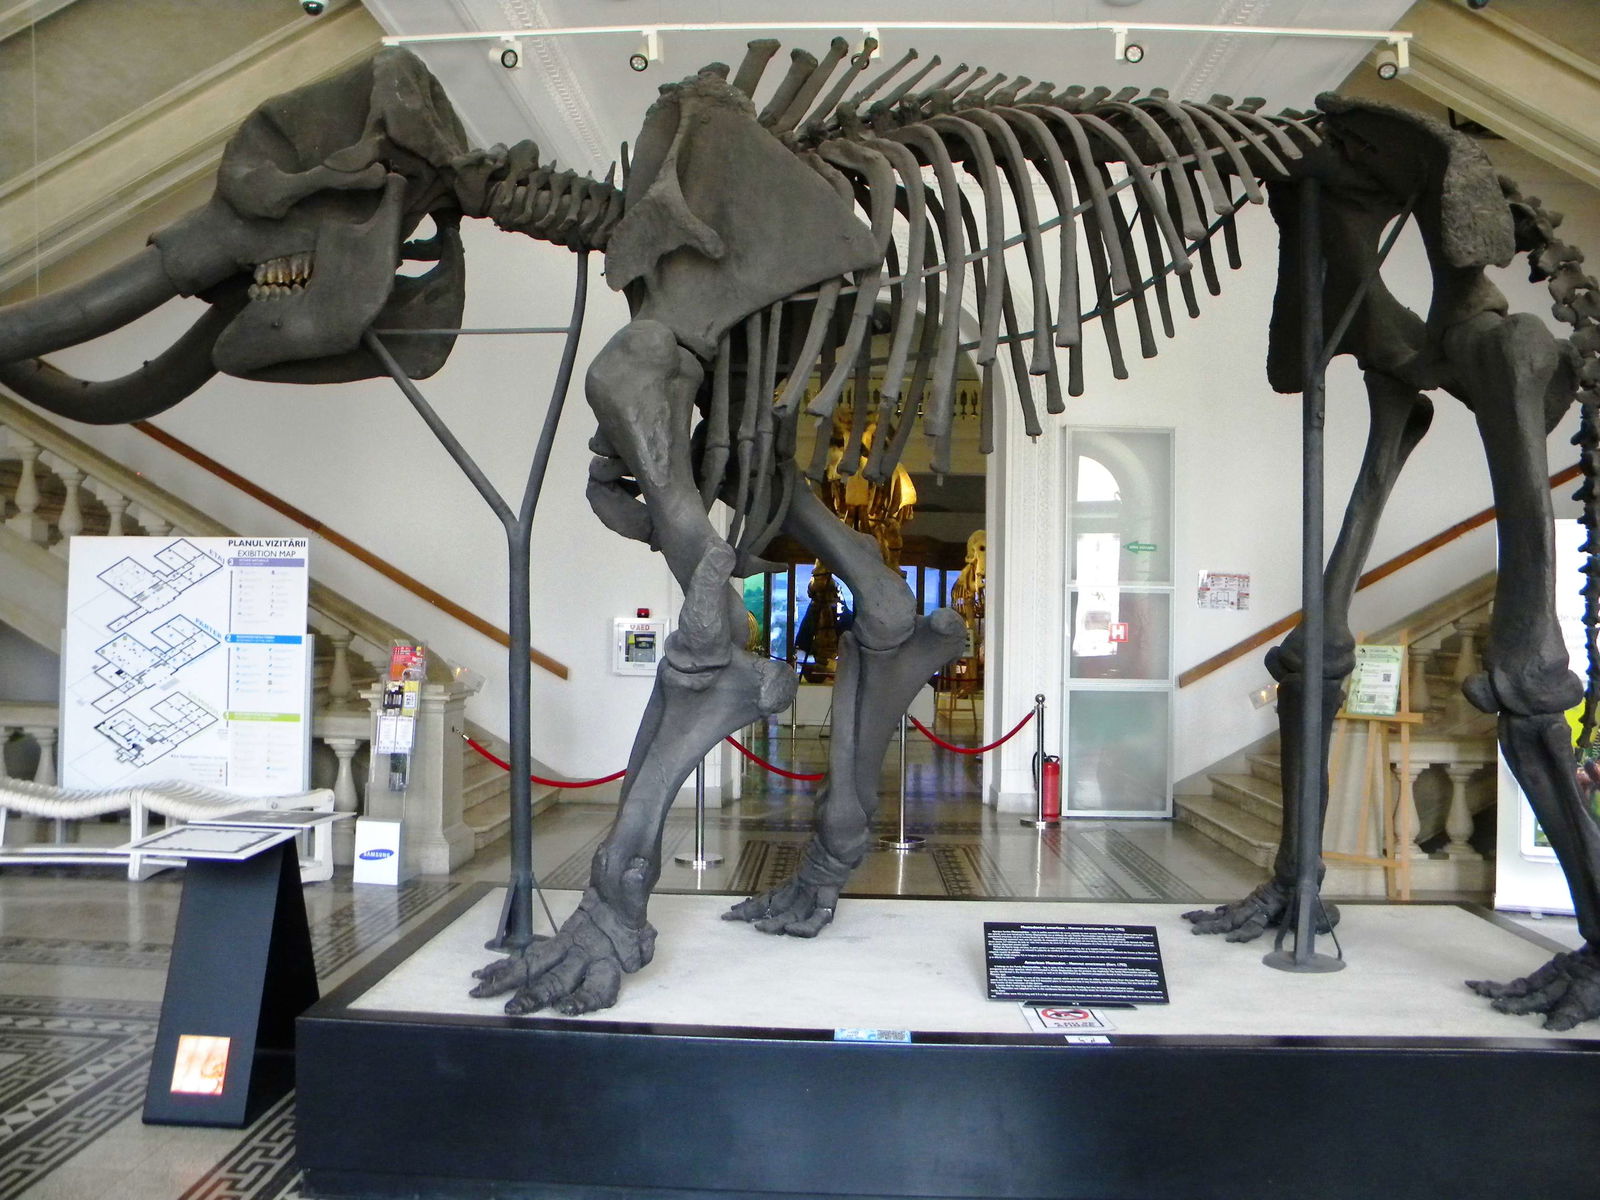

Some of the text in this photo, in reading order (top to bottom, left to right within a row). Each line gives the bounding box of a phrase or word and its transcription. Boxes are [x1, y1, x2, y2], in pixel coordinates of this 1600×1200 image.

[228, 539, 264, 547] PLANUL
[237, 550, 297, 558] EXIBITION MAP
[1111, 624, 1125, 639] H
[363, 850, 390, 858] SAMSUNG
